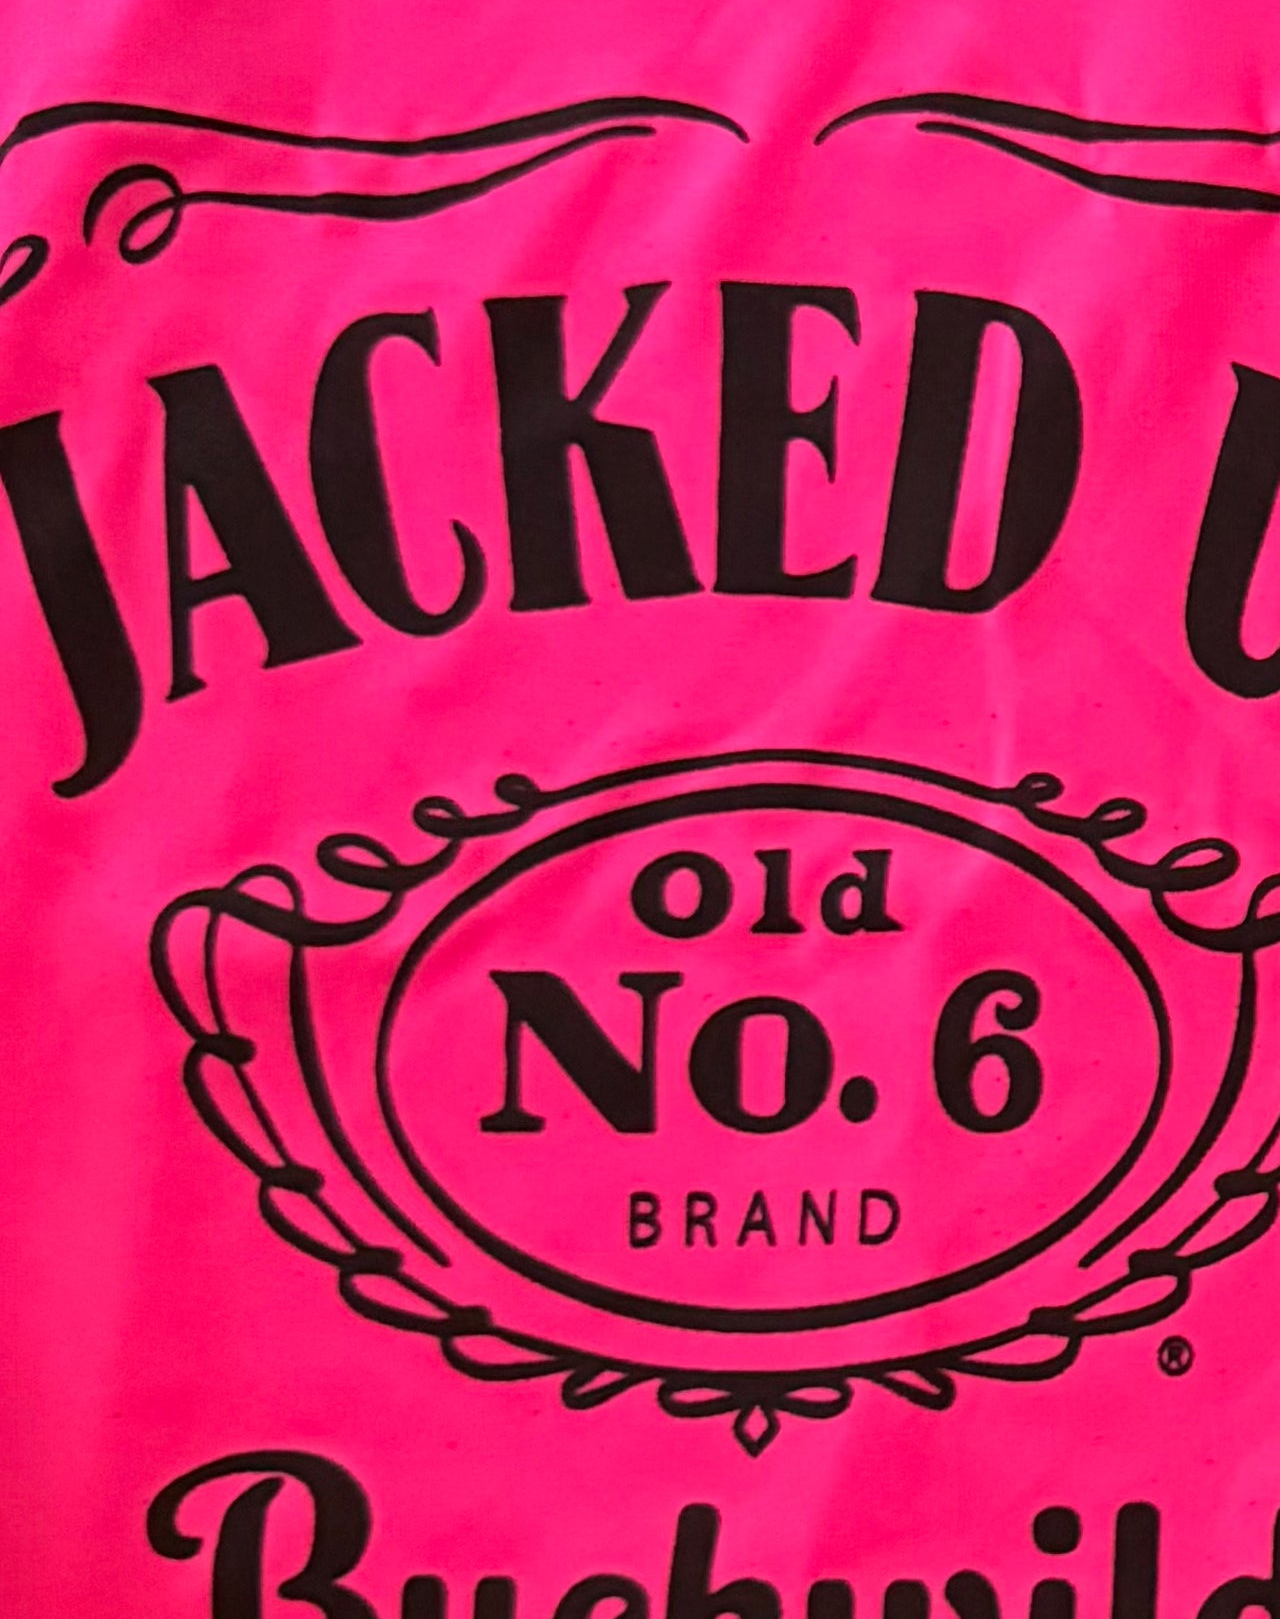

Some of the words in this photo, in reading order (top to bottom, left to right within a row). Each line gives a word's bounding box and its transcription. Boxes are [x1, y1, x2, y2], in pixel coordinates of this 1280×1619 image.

[0, 281, 1083, 798] JACKED
[631, 850, 902, 939] Old
[481, 971, 876, 1134] No.
[933, 970, 1042, 1133] 6
[630, 1190, 899, 1248] BRAND
